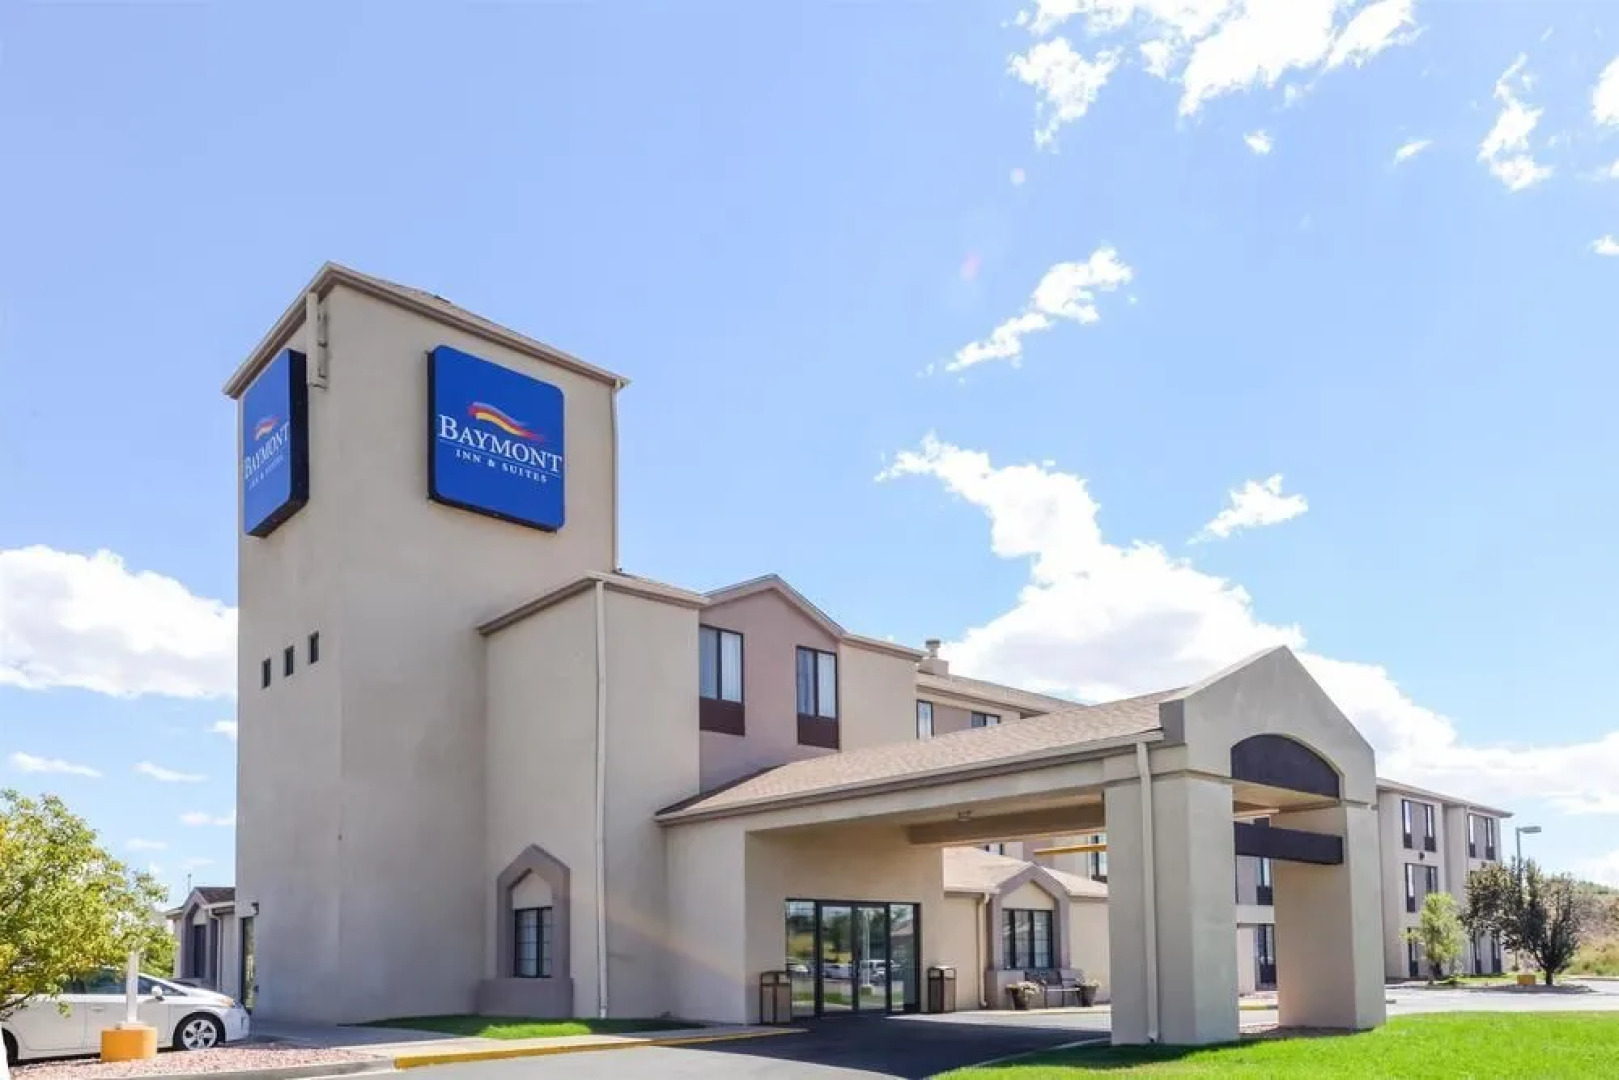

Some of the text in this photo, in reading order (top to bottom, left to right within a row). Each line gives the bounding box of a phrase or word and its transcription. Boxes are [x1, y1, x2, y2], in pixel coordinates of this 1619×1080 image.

[439, 414, 562, 472] BAYMONT
[455, 449, 547, 483] INN & SUITES
